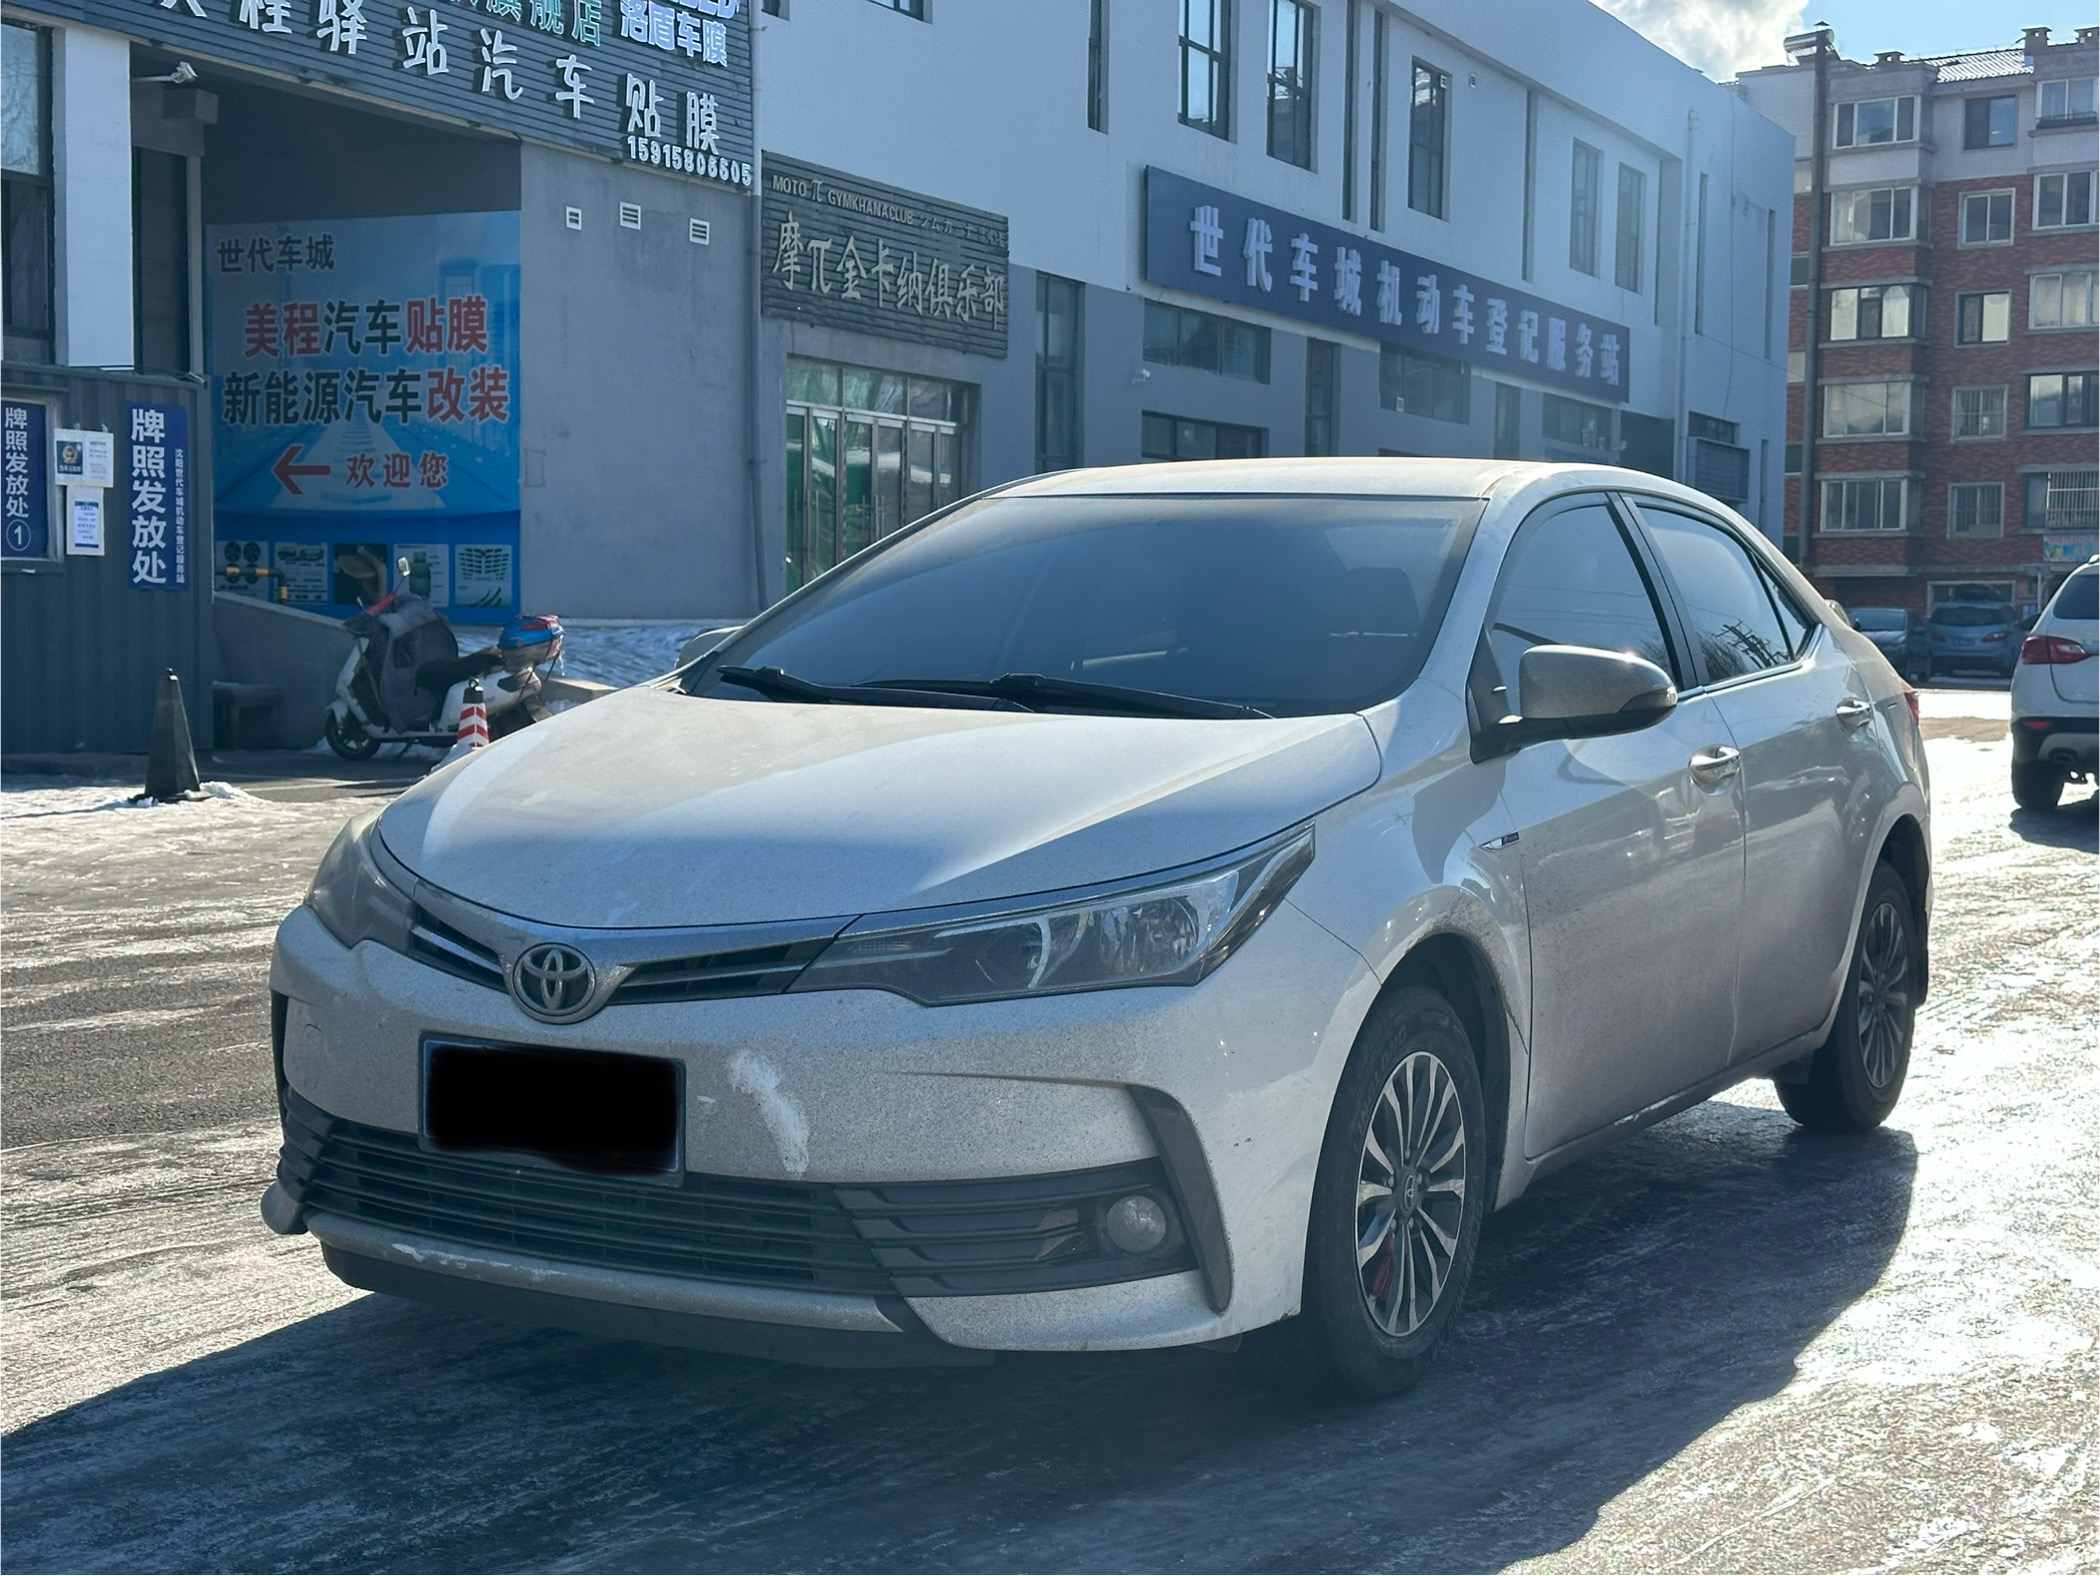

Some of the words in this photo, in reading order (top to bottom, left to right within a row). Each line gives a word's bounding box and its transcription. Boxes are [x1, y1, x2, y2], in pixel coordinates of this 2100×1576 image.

[158, 0, 720, 155] 程驿站汽车贴膜
[772, 175, 807, 197] MOTO
[827, 189, 914, 225] GYMKHANACLUB
[216, 234, 335, 273] 世代车城
[244, 295, 488, 358] 美程汽车贴膜
[1189, 204, 1621, 386] 世代车城机动车登记服务站
[223, 366, 509, 425] 新能源汽车改装
[5, 407, 29, 518] 牌照发放处
[346, 452, 449, 489] 欢迎您
[131, 408, 167, 585] 牌照发放处
